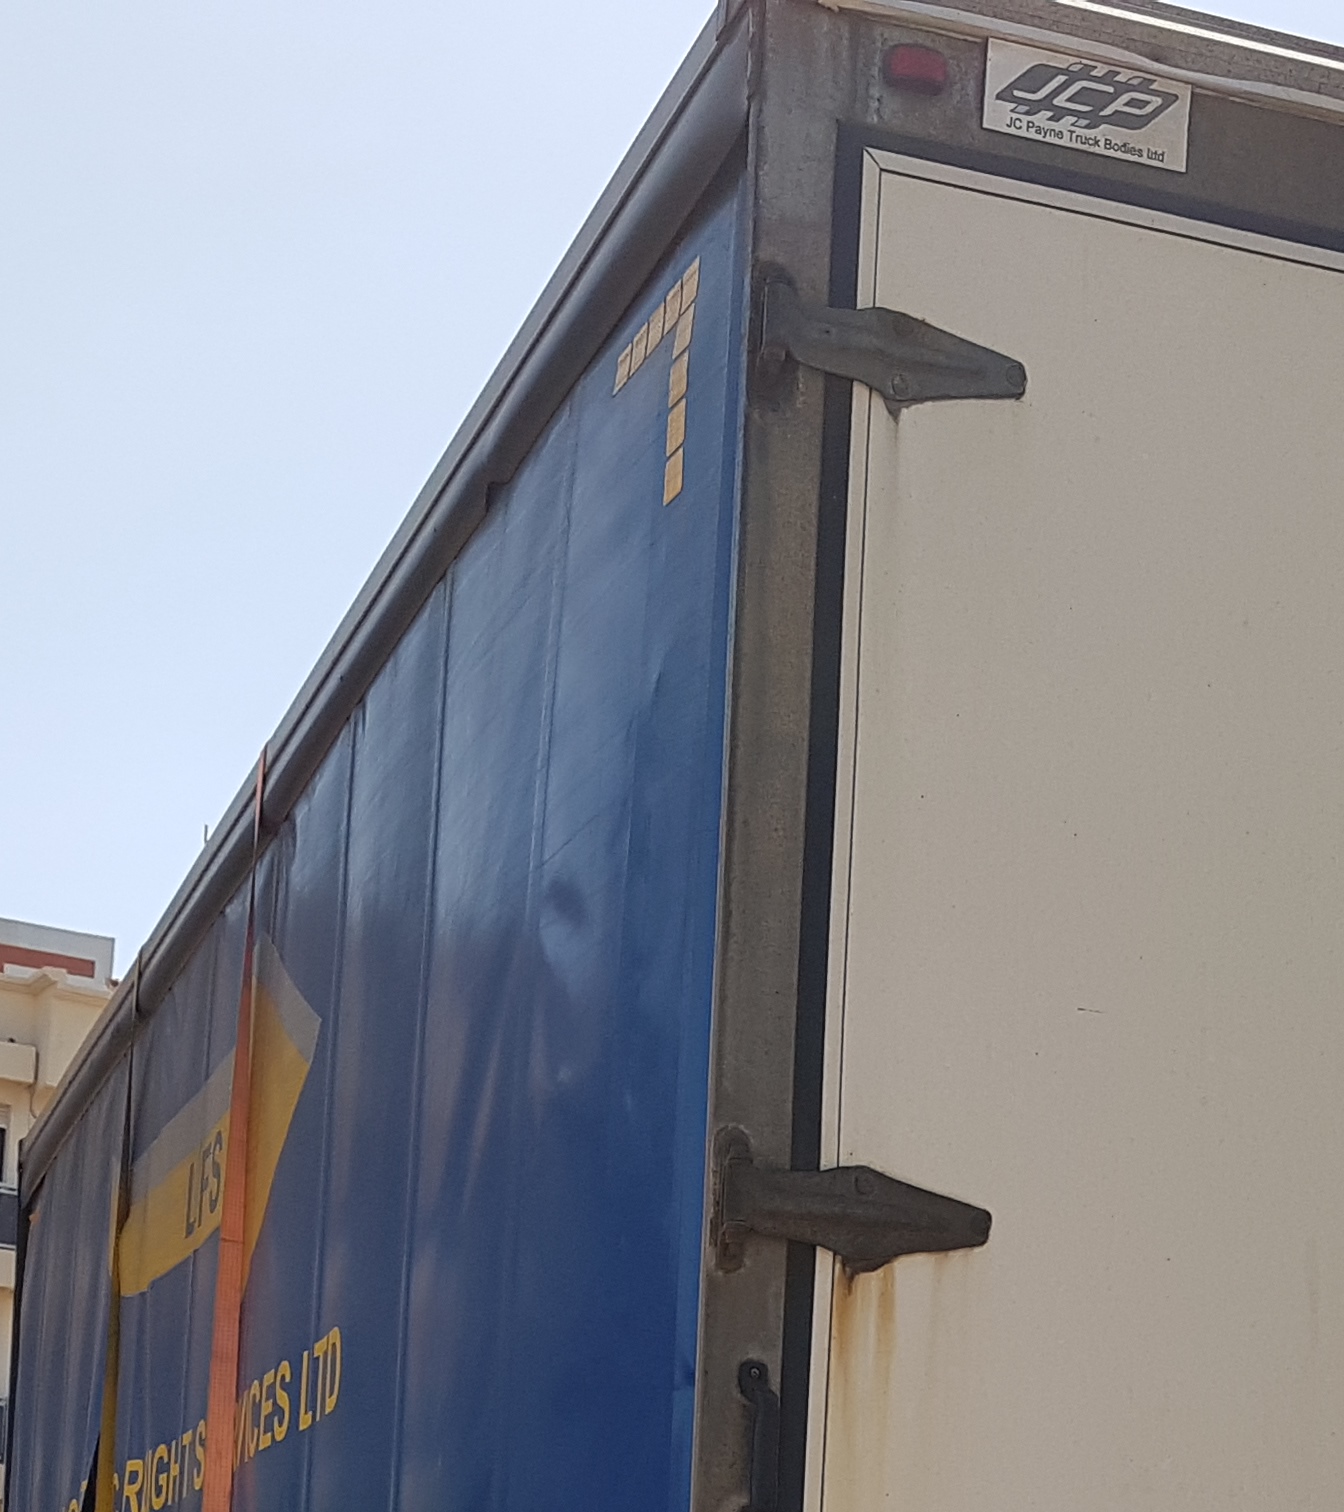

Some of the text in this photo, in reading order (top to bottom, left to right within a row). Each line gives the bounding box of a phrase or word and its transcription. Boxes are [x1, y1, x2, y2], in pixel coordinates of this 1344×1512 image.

[1012, 73, 1164, 117] JCP
[1005, 116, 1166, 163] JC Payne Truck Bodies Ltd
[184, 1129, 223, 1239] LFS
[298, 1325, 341, 1432] LTD
